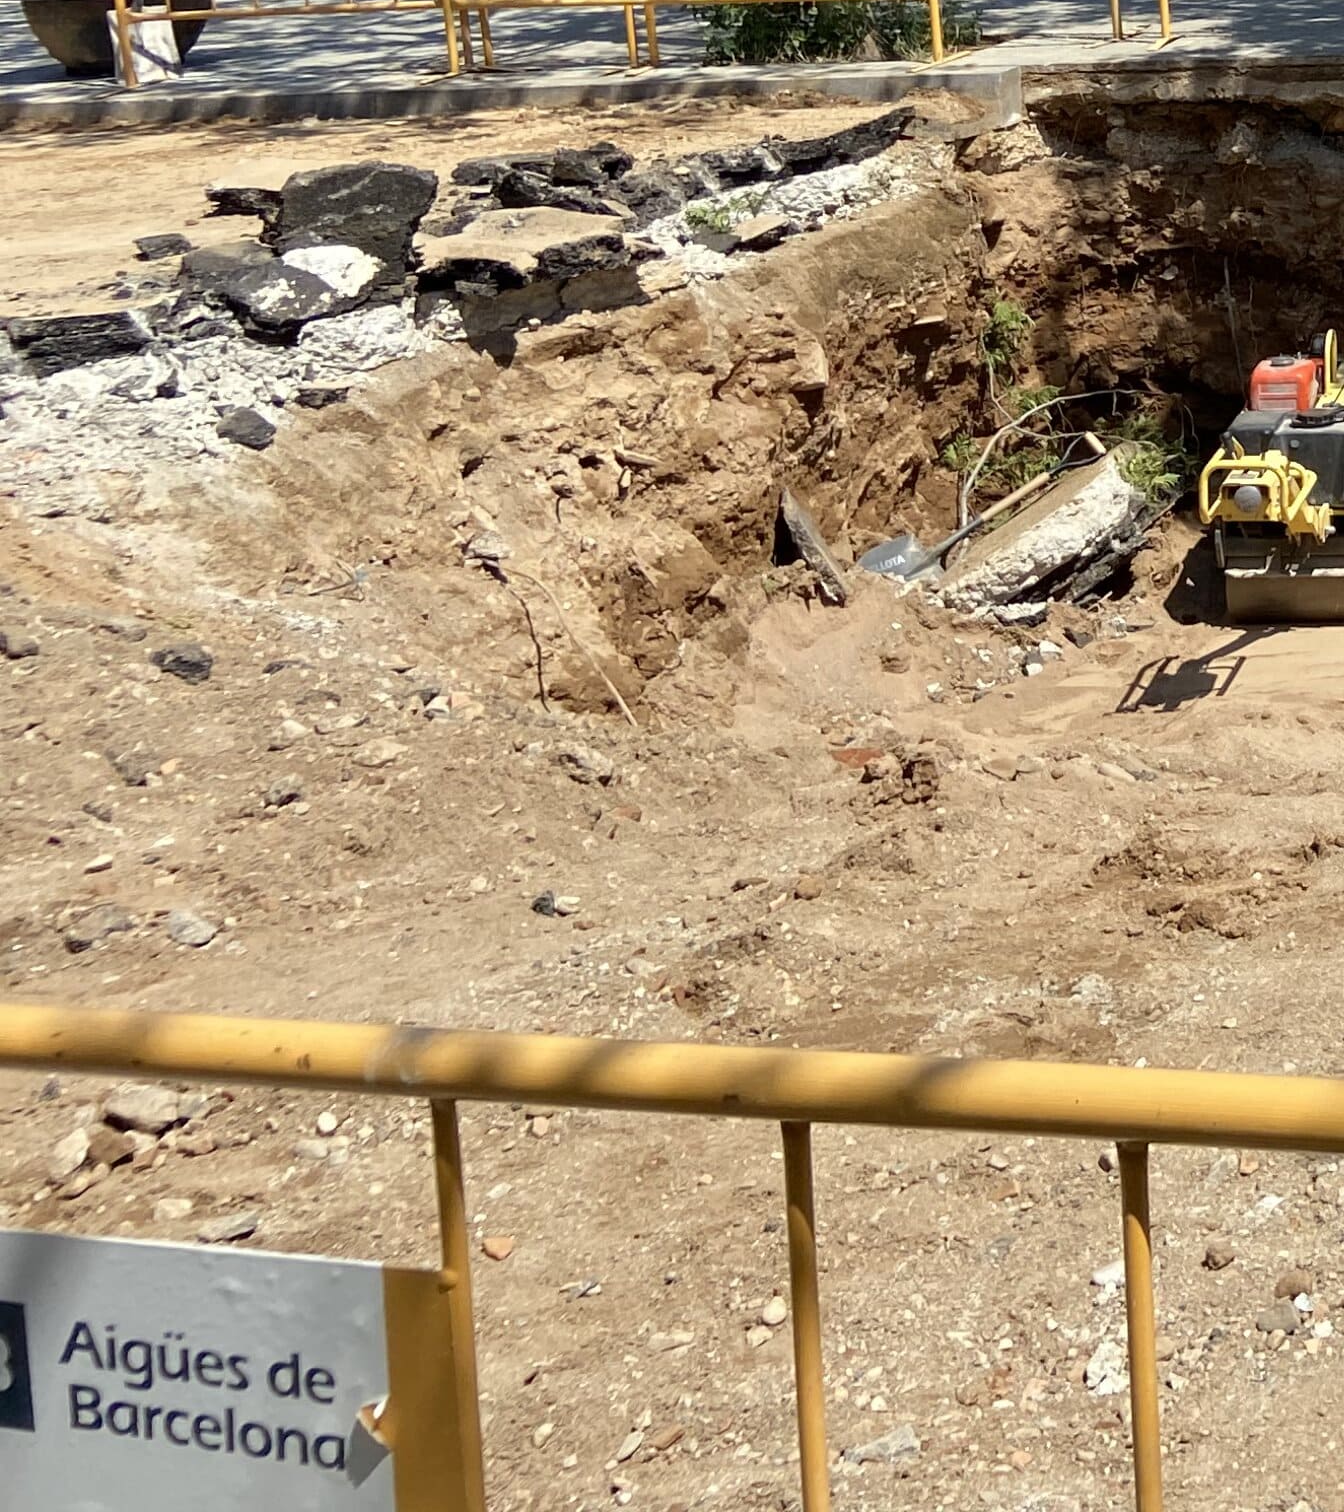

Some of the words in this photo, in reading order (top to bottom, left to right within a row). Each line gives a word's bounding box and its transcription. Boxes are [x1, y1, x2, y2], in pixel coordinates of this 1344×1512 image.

[58, 1320, 251, 1391] Aigües
[266, 1353, 336, 1405] de
[67, 1383, 347, 1471] Barcelona
